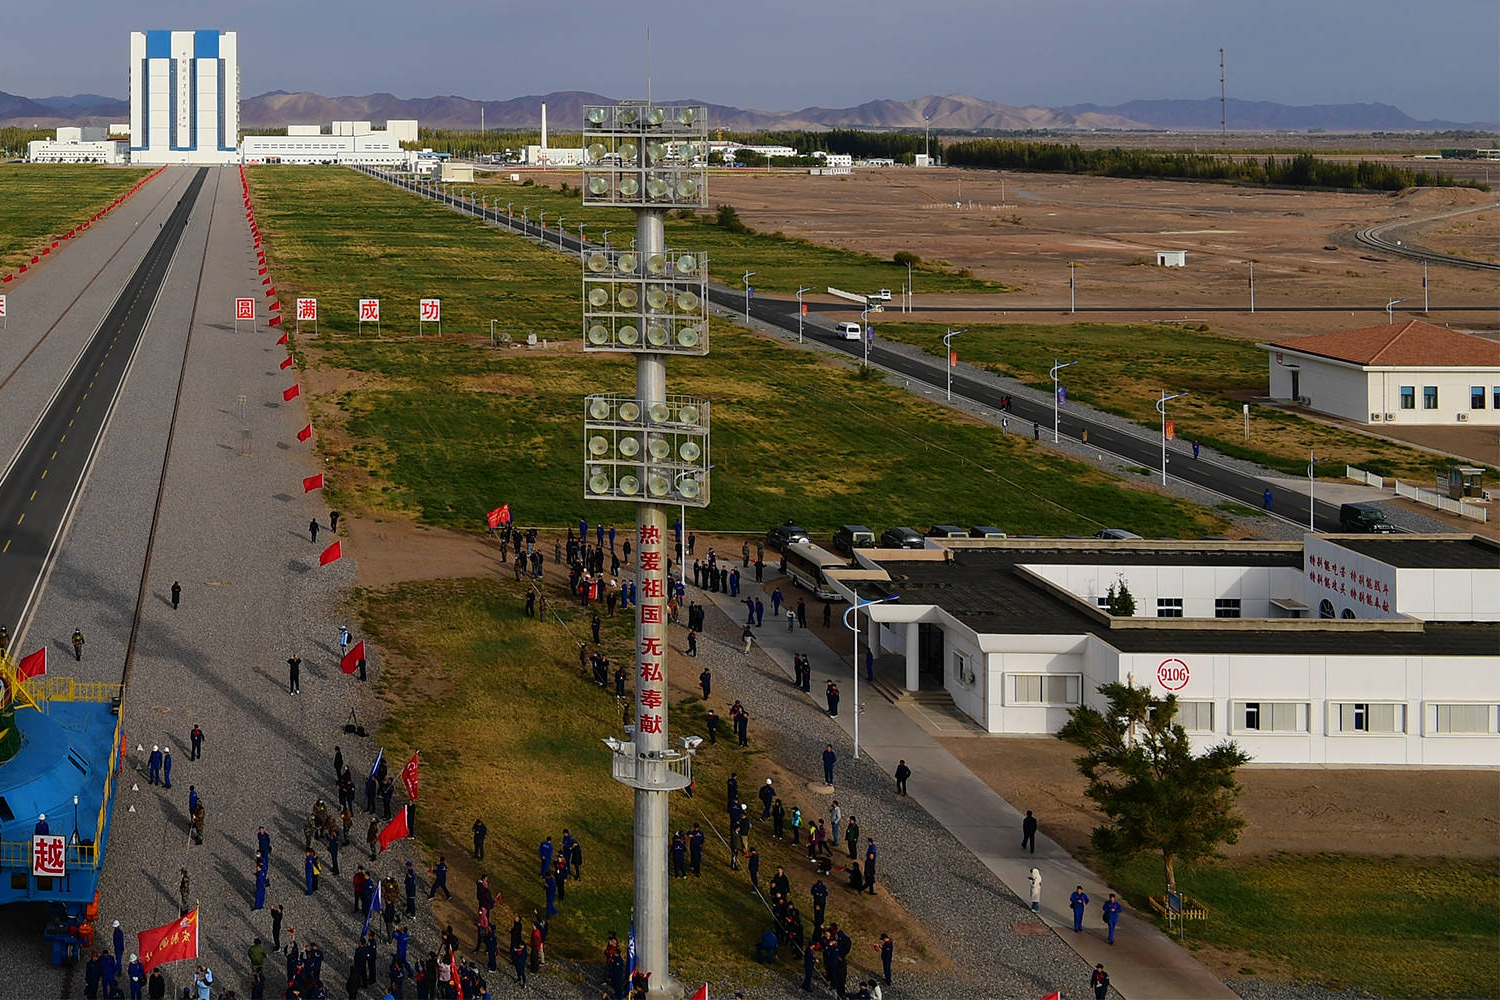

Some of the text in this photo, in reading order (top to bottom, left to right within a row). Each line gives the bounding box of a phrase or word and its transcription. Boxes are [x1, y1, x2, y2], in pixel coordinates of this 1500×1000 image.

[237, 299, 440, 321] 圆满成功
[640, 524, 665, 735] 热爱祖国 无私奉献
[1160, 668, 1186, 682] 9106
